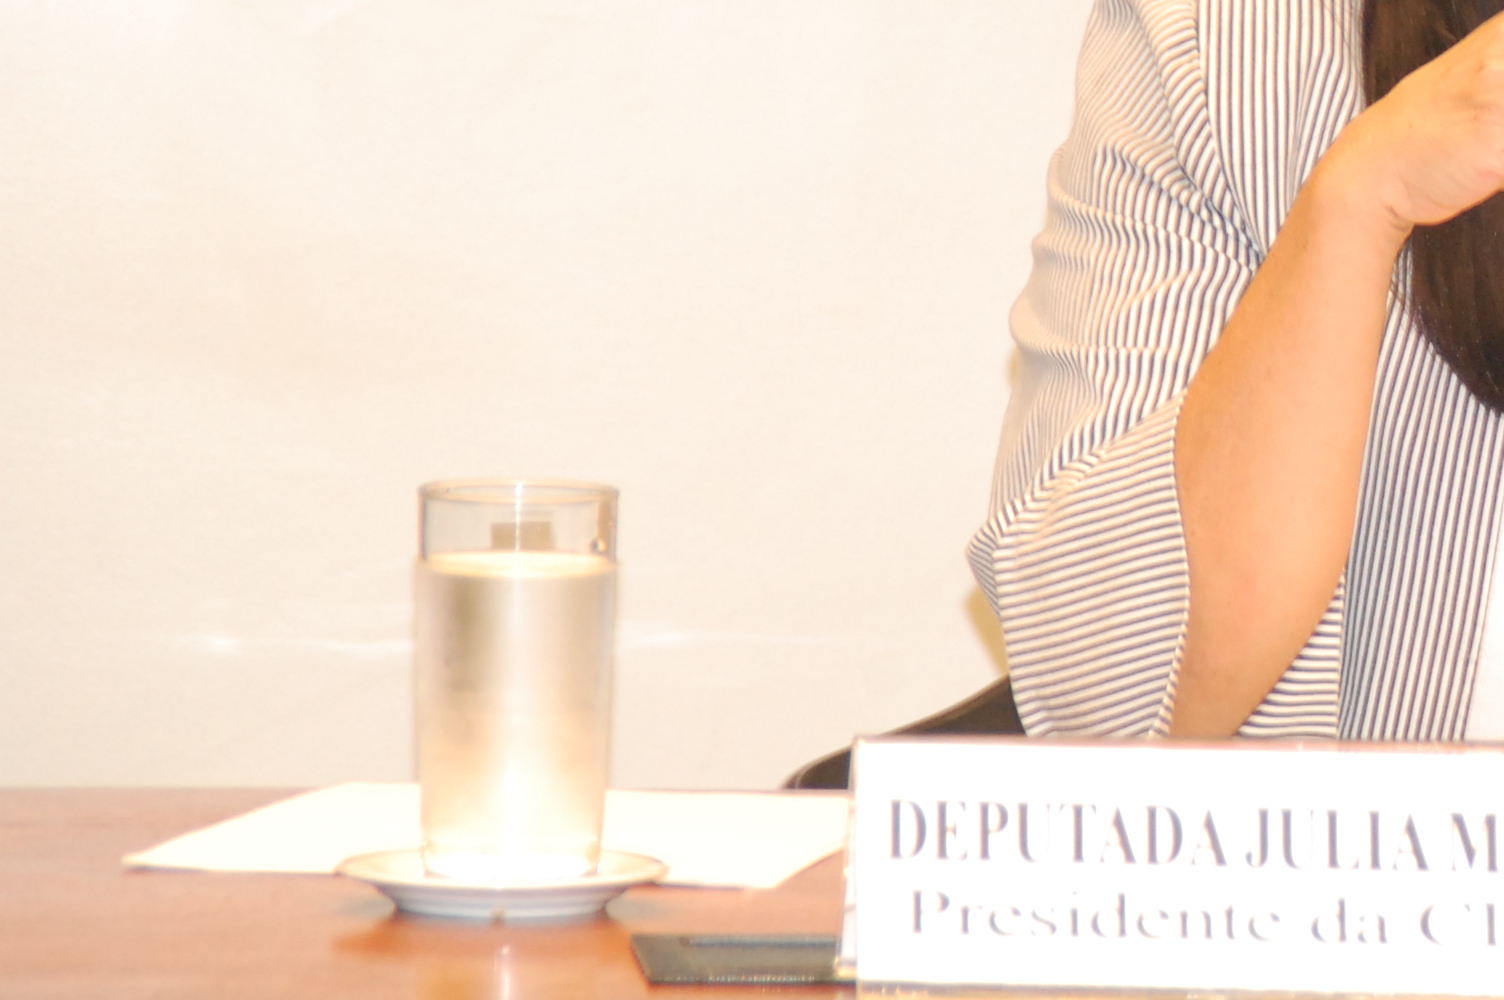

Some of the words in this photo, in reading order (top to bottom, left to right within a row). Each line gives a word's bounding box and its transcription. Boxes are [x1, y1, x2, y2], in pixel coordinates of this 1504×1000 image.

[890, 799, 1228, 867] DEPUTADA
[1245, 807, 1430, 872] JULIA
[912, 889, 1282, 942] Presidente
[1310, 897, 1389, 944] da
